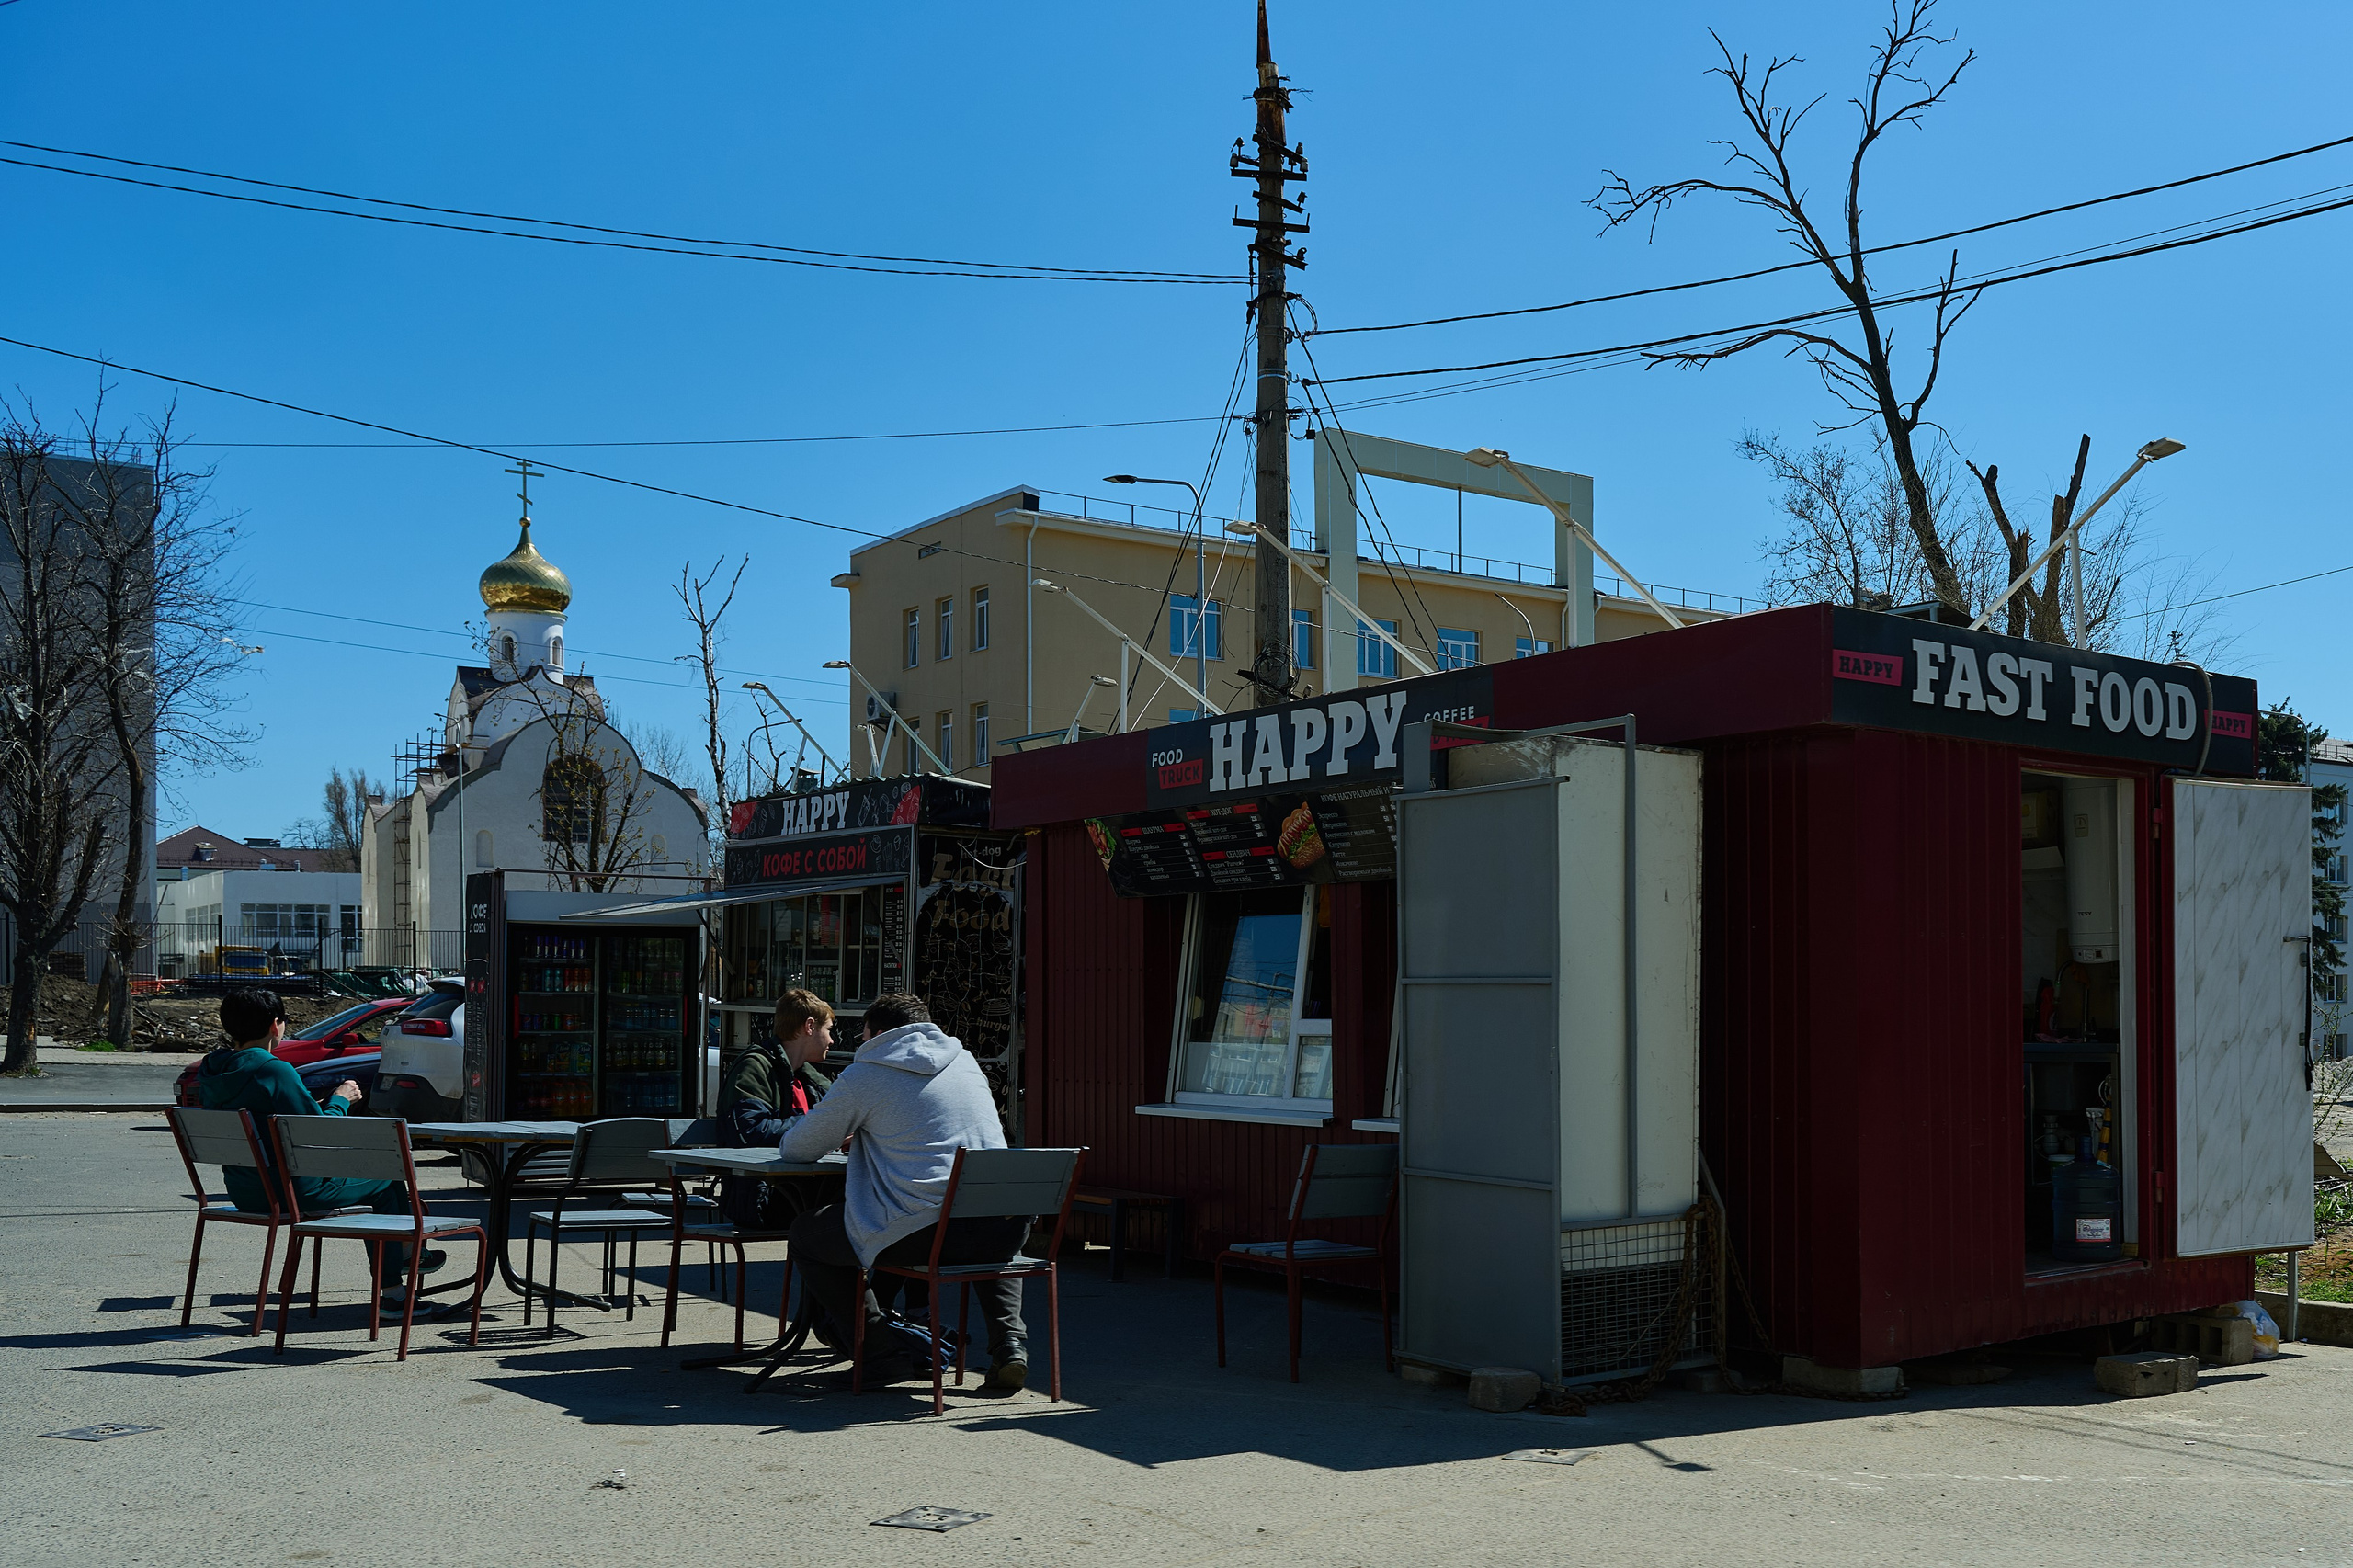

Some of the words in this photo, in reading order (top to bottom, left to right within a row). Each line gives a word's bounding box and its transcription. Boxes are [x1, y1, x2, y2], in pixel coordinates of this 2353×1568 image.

[1839, 655, 1893, 679] HAPPY
[1912, 638, 2053, 721] FAST
[2071, 666, 2197, 741] FOOD
[1423, 705, 1475, 723] COFFEE
[1209, 691, 1407, 792] HAPPY
[1152, 748, 1184, 768] FOOD
[1161, 765, 1200, 785] TRUCK
[1320, 794, 1338, 803] КОФЕ
[1338, 786, 1383, 801] НАТУРАЛЬНЫЙ
[781, 790, 850, 835] HAPPY
[1210, 807, 1233, 817] ХОТ-ДОГ
[762, 849, 801, 877] КОФЕ
[804, 848, 813, 874] С
[817, 837, 867, 872] СОБОЙ
[931, 899, 1011, 932] Food
